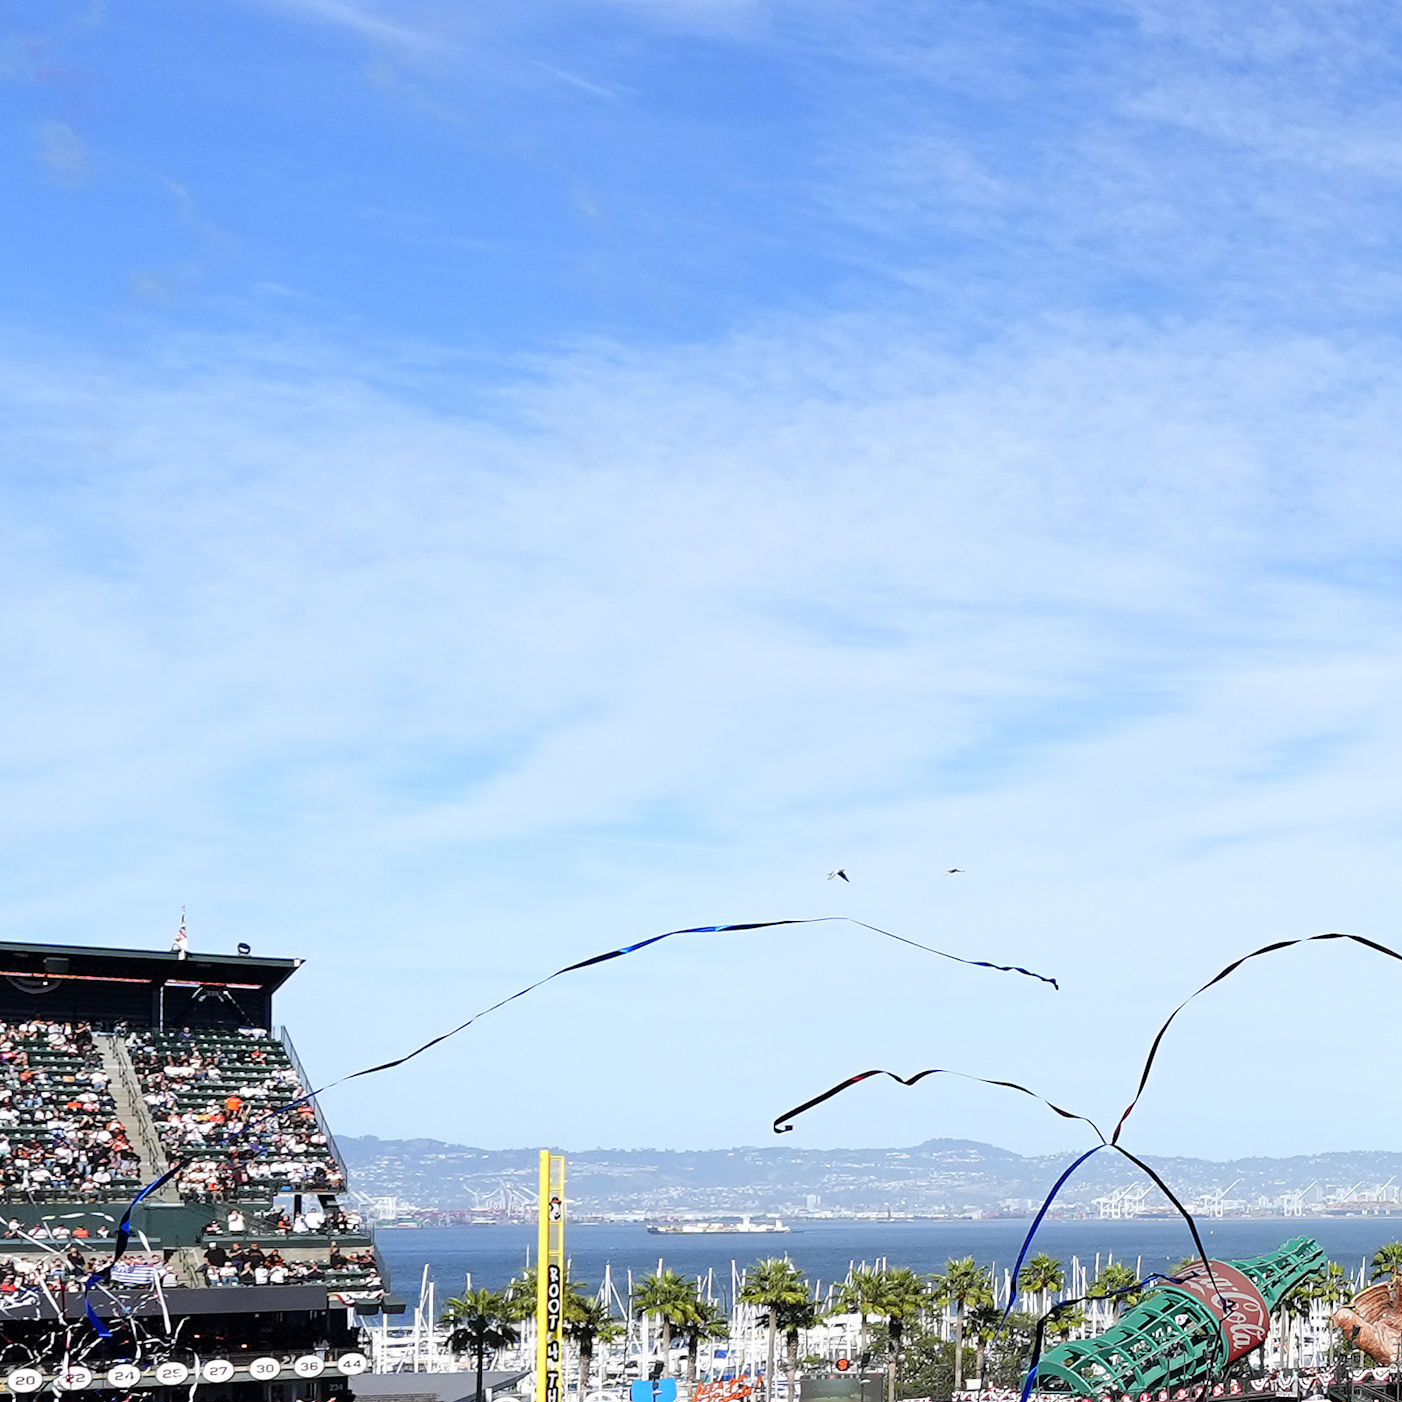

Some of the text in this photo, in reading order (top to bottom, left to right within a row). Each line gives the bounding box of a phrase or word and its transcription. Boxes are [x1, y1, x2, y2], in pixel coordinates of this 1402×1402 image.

[548, 1265, 561, 1331] ROOT
[546, 1341, 559, 1362] 4
[256, 1364, 274, 1374] 30
[300, 1361, 319, 1372] 36
[343, 1359, 361, 1368] 44
[114, 1371, 135, 1382] 24
[162, 1368, 183, 1379] 25
[209, 1366, 228, 1376] 27
[15, 1375, 36, 1386] 20
